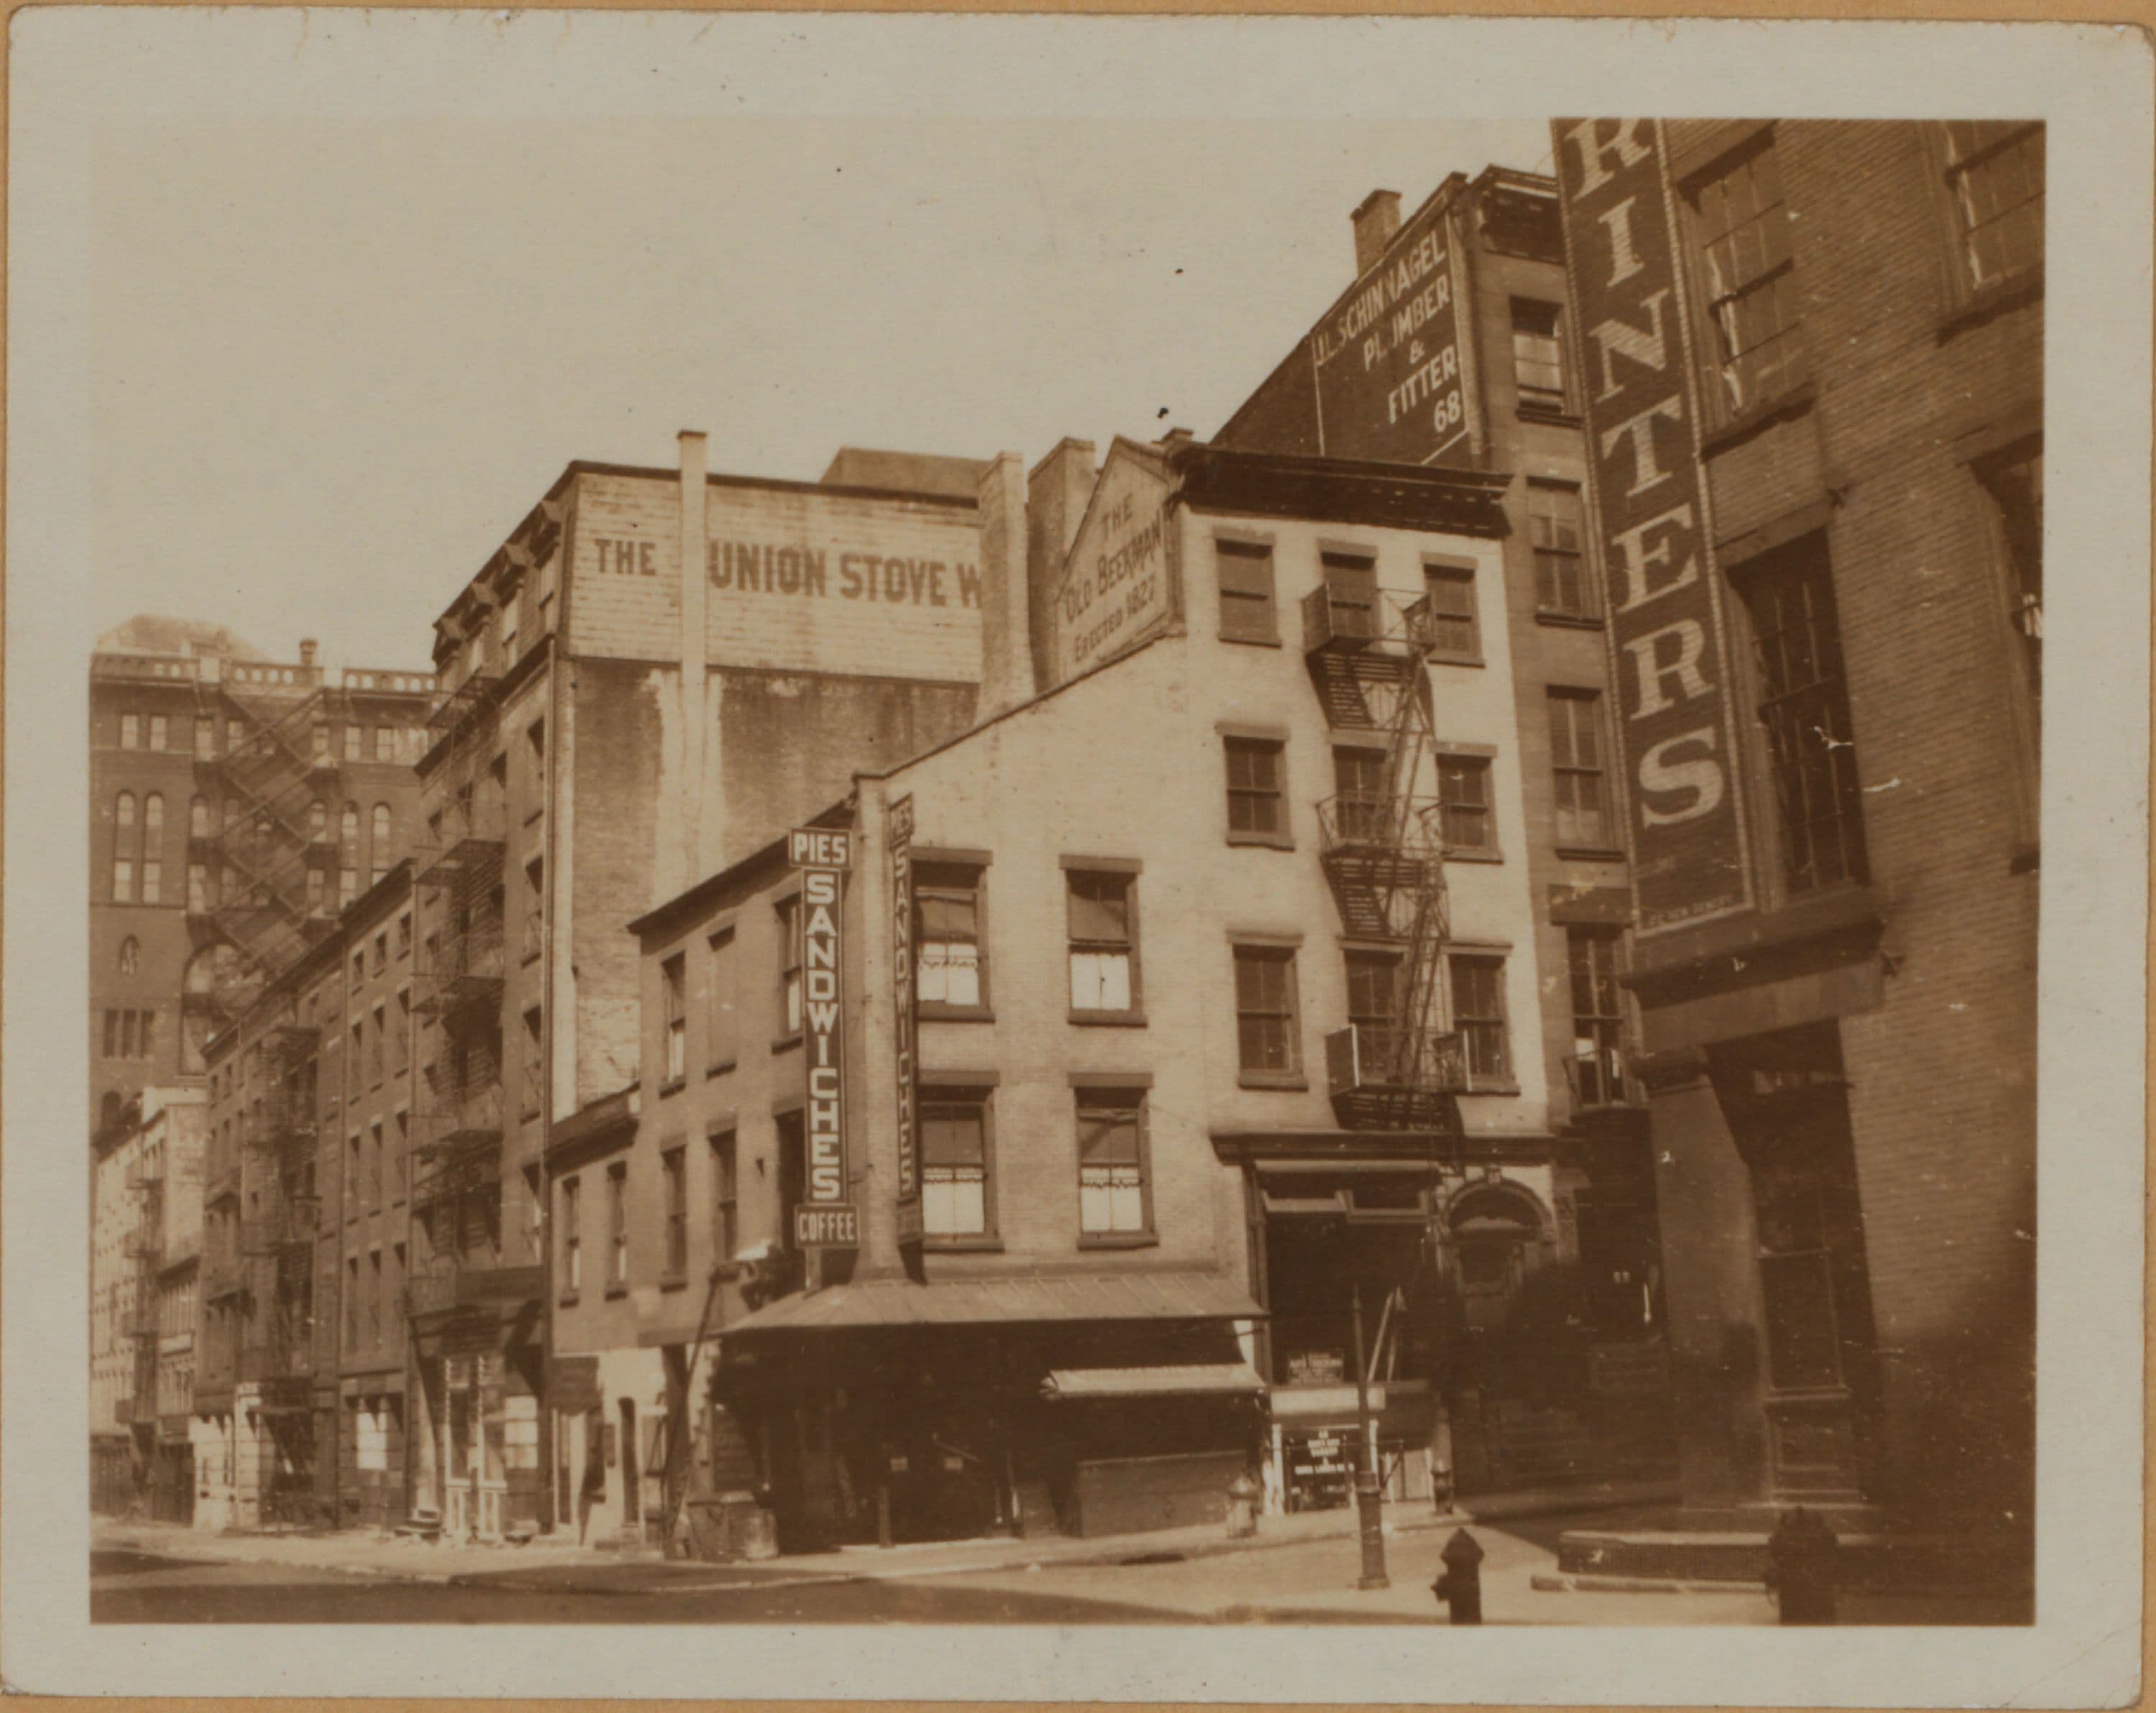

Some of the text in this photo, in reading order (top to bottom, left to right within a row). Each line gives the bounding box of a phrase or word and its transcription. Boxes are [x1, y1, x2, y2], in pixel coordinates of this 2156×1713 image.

[1410, 339, 1426, 364] &
[1388, 346, 1458, 425] FITTER
[1434, 390, 1461, 433] 68
[1102, 492, 1134, 540] THE
[593, 538, 657, 576] THE
[708, 540, 826, 599] UNION
[839, 553, 947, 606] STOVE
[1066, 579, 1091, 624] OLD
[793, 832, 847, 864] PIES
[805, 873, 841, 1200] SANDWICHES
[798, 1212, 855, 1242] COFFEE
